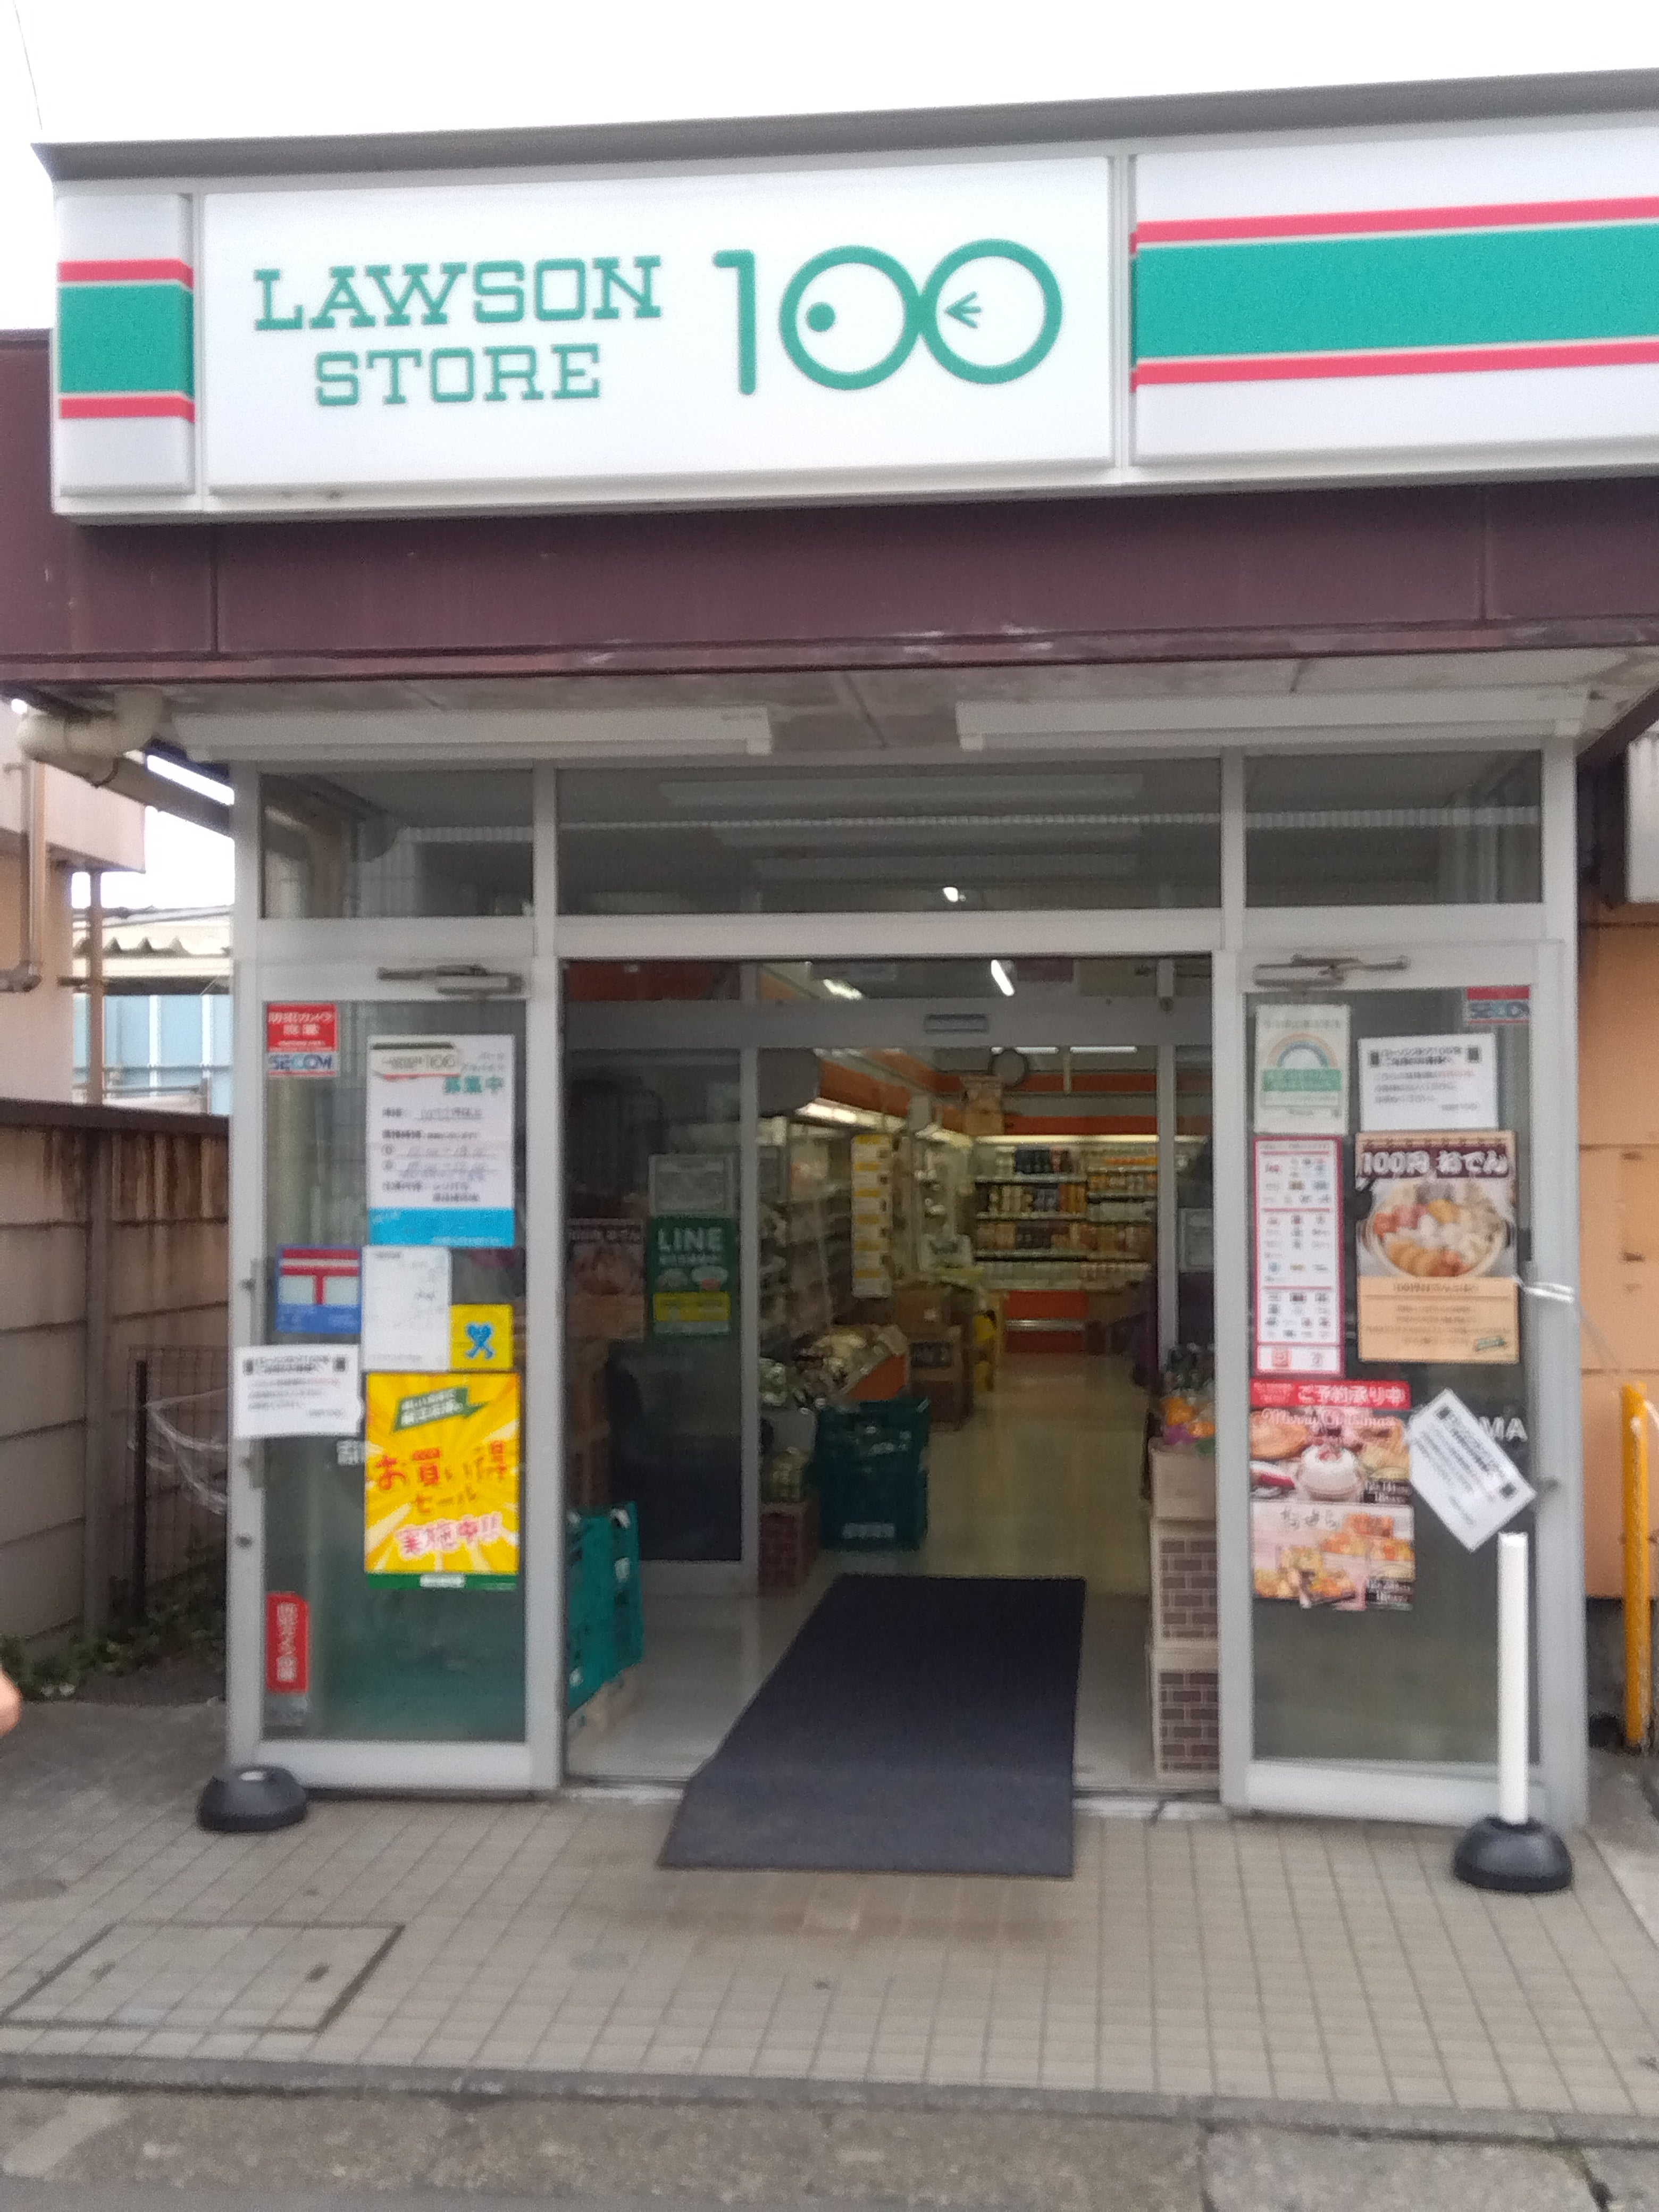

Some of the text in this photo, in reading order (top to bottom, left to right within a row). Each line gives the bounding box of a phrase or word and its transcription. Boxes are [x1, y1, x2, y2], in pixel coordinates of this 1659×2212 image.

[254, 255, 663, 331] LAWSON
[713, 238, 1063, 396] 100
[315, 343, 601, 406] STORE
[269, 1054, 333, 1071] SECOM
[657, 1227, 723, 1253] LINE
[375, 1442, 506, 1490] お買い得
